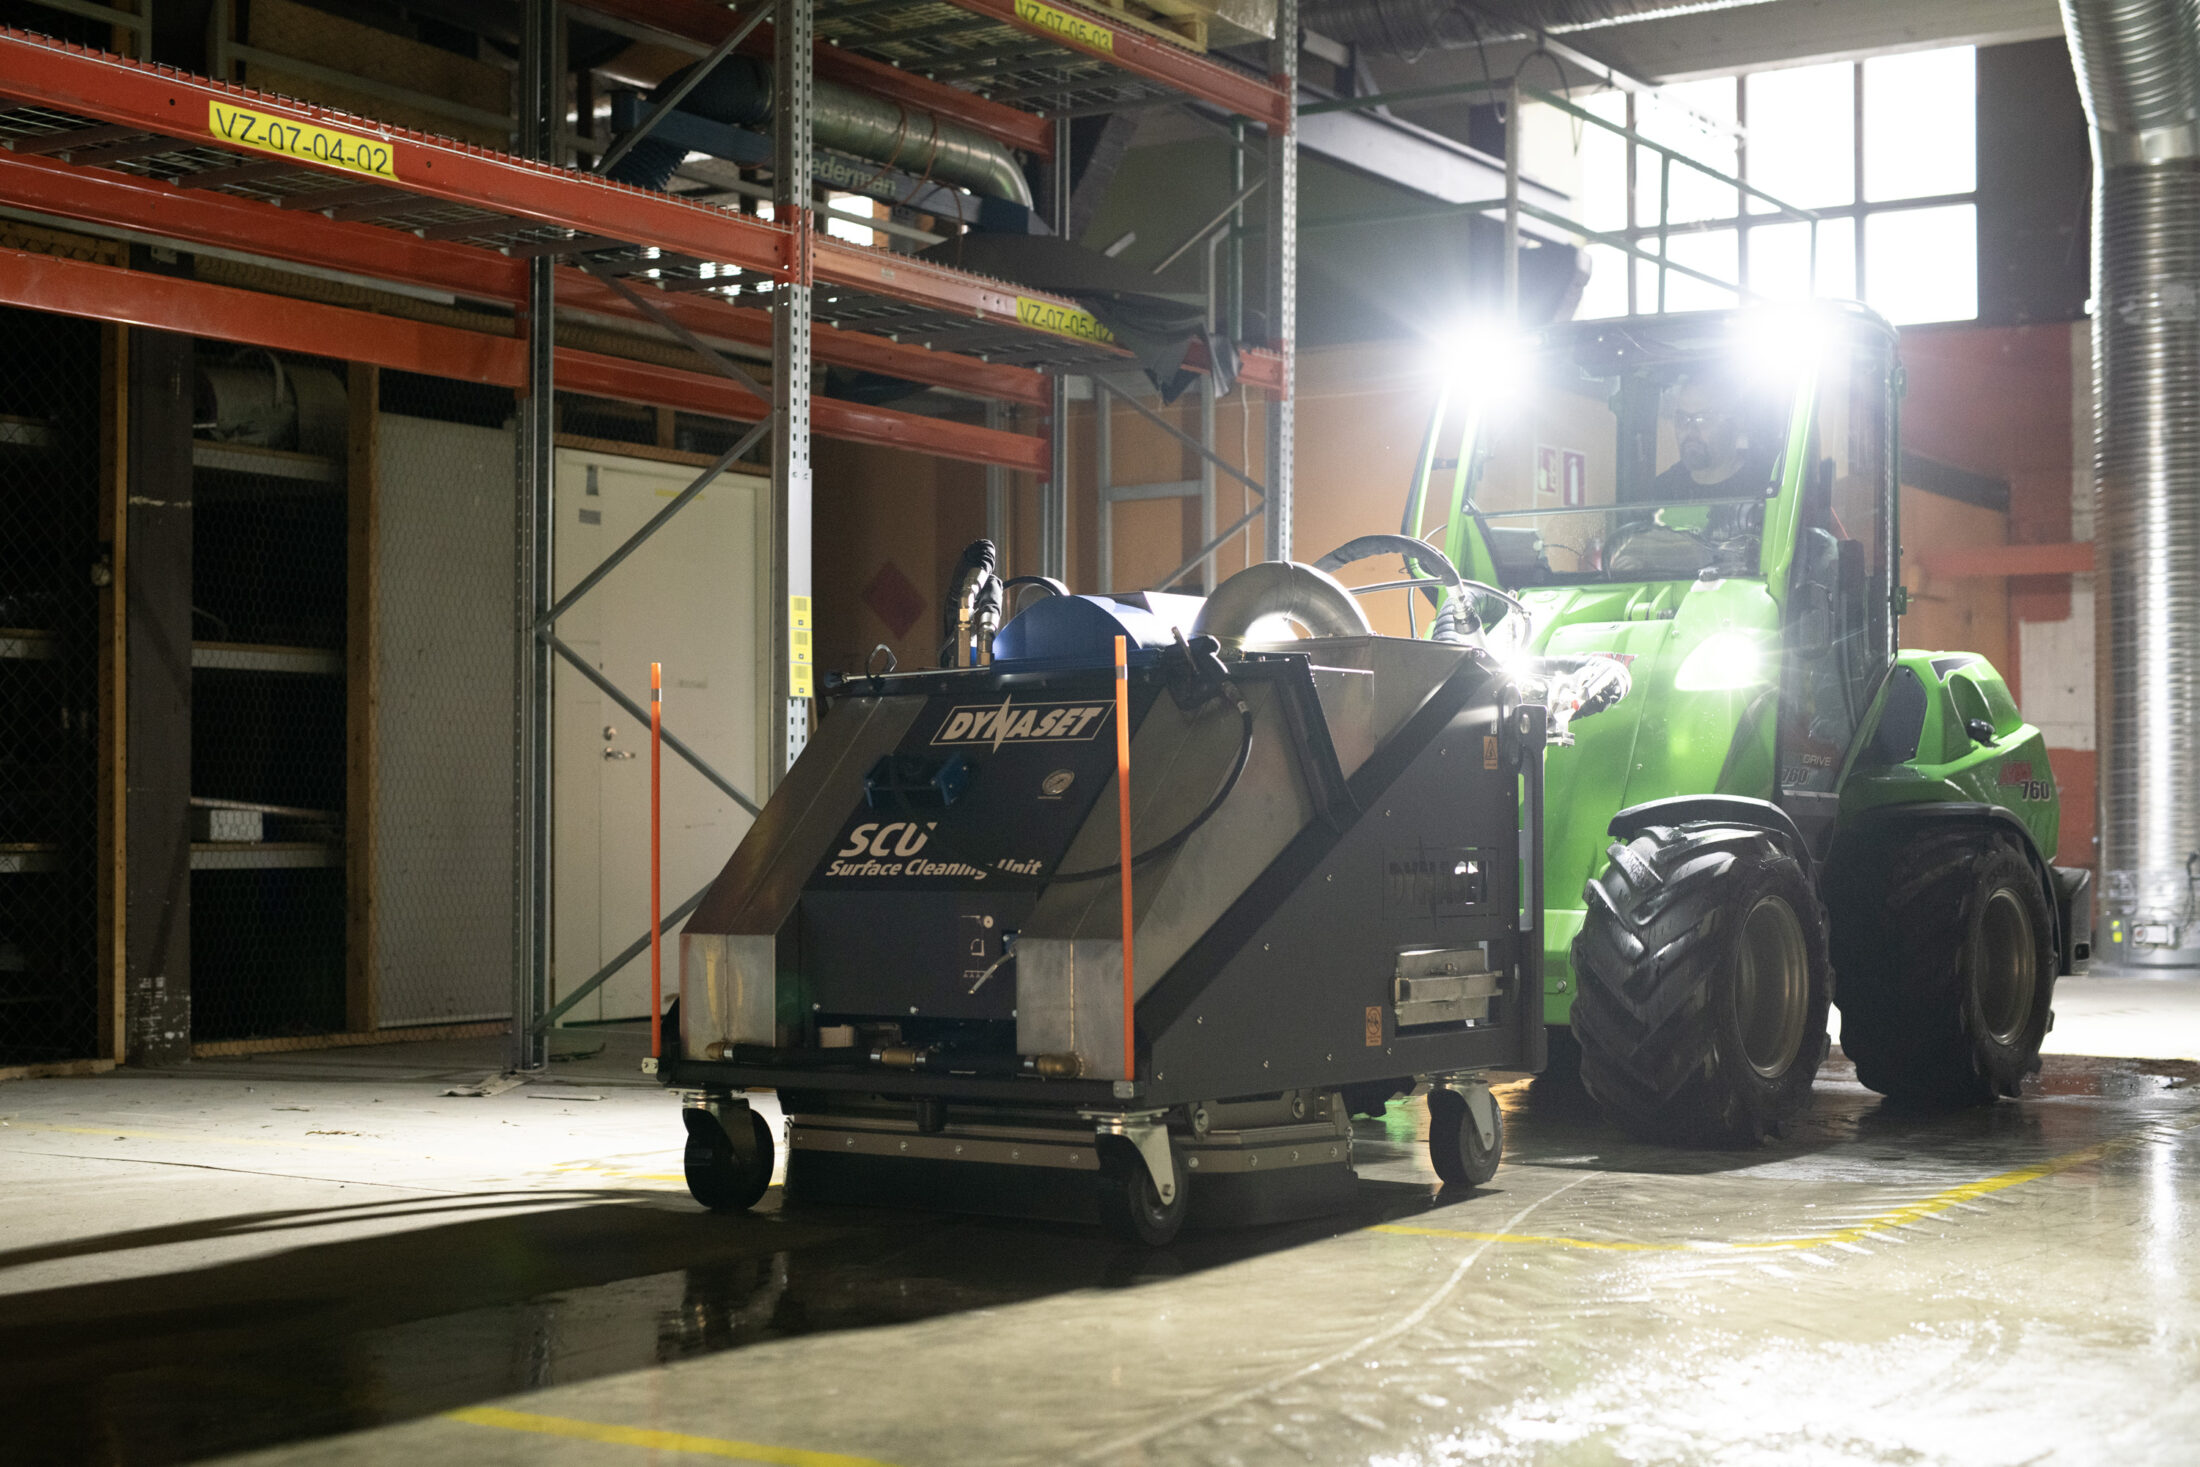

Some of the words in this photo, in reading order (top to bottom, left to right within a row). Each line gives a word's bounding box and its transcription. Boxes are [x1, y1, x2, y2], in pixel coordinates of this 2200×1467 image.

[216, 108, 391, 176] VZ-07-04-02
[811, 155, 897, 196] ederman
[942, 694, 1104, 753] DYNASET
[2020, 780, 2052, 802] 760
[838, 822, 938, 857] SCU
[825, 859, 902, 877] Surface
